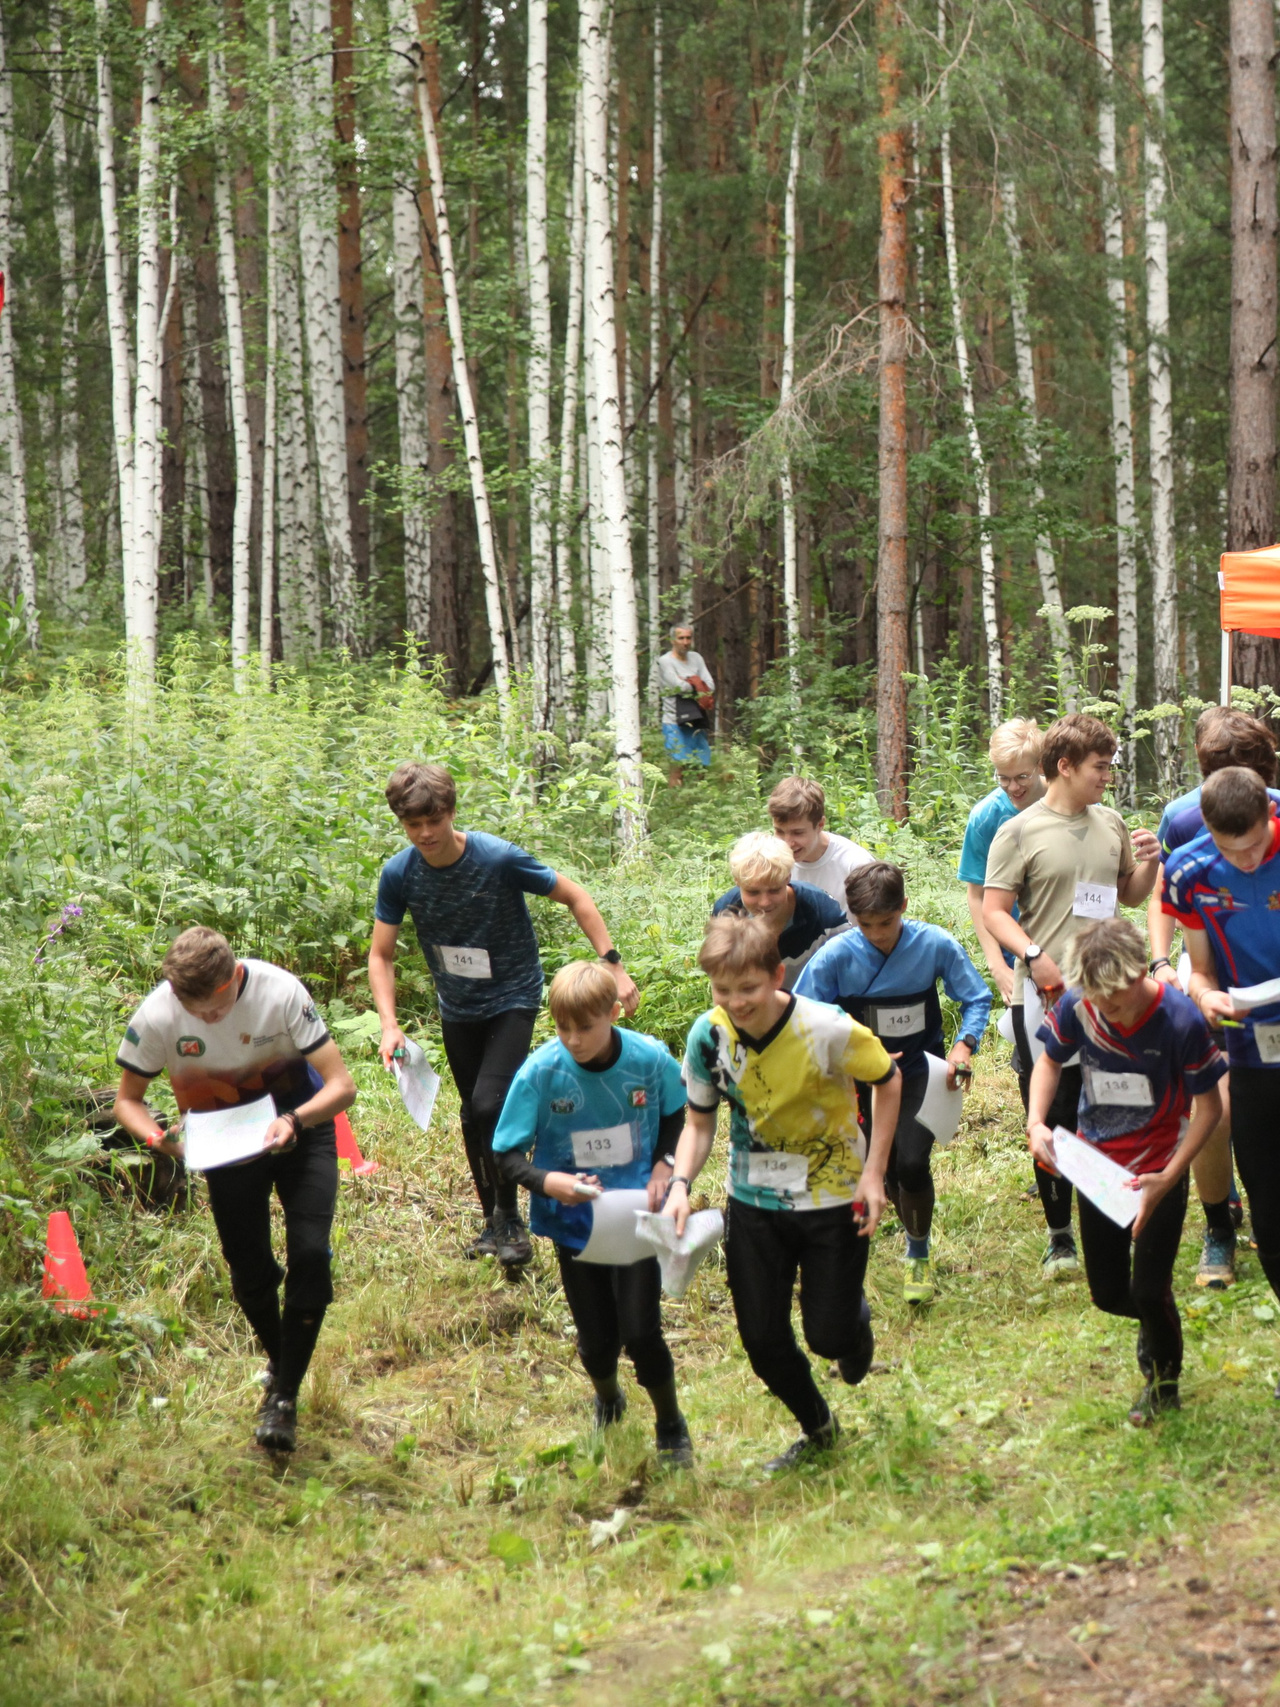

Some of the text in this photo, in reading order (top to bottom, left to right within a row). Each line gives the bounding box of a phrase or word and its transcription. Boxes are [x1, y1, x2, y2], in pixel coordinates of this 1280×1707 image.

[1084, 892, 1102, 904] 144
[454, 954, 473, 965] 141
[889, 1014, 911, 1025] 143
[586, 1138, 611, 1151] 133
